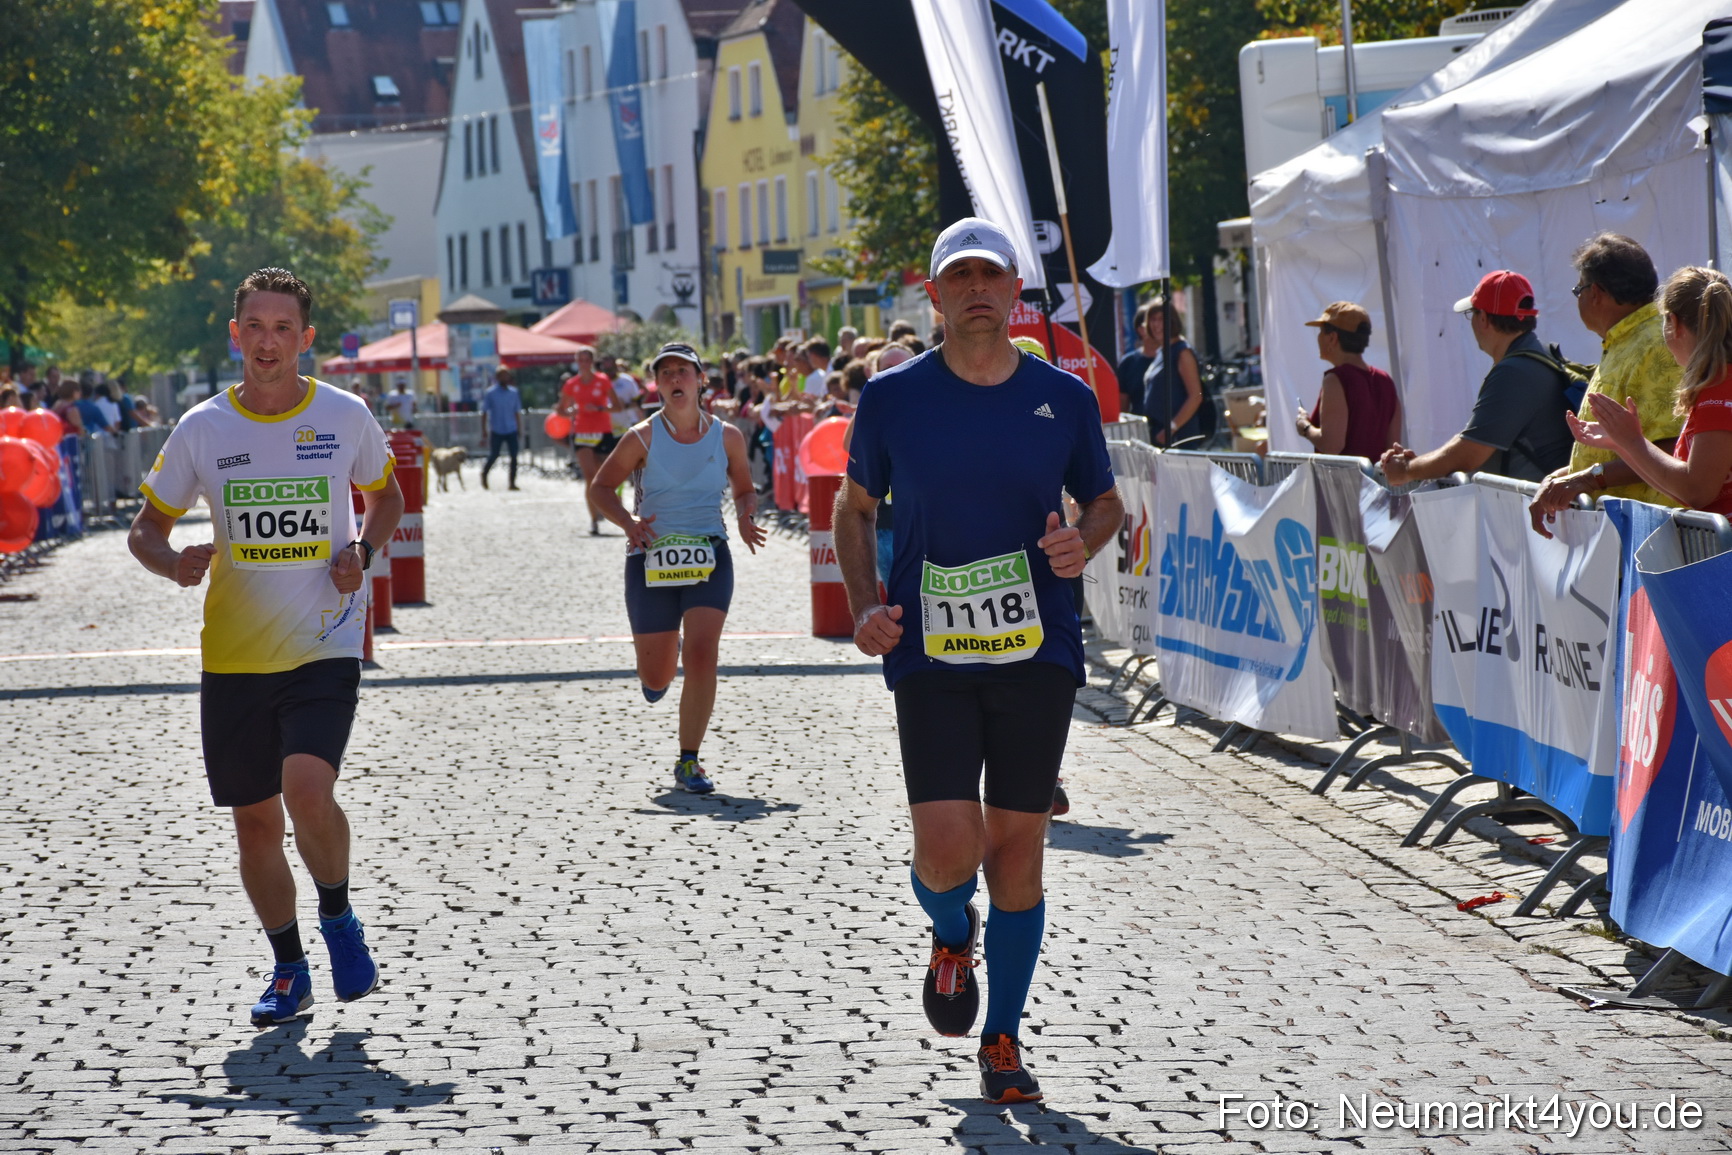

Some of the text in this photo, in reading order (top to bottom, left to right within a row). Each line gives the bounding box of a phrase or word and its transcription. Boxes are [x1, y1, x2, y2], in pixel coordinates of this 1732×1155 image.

[996, 24, 1056, 74] RKT
[1009, 314, 1040, 325] EARS
[1034, 410, 1055, 419] adidas
[296, 430, 315, 443] 20
[296, 443, 341, 451] Neumarkter
[296, 451, 333, 460] Stadtlauf
[218, 454, 250, 466] BOCK
[230, 480, 322, 504] BOCK
[238, 510, 319, 539] 1064
[240, 545, 319, 560] YEVGENIY
[653, 548, 708, 567] 1020
[811, 543, 838, 566] VIA
[658, 570, 704, 580] DANIELA
[928, 558, 1022, 594] BOCK
[937, 592, 1025, 629] 1118
[943, 634, 1027, 653] ANDREAS
[1694, 800, 1732, 843] MOB
